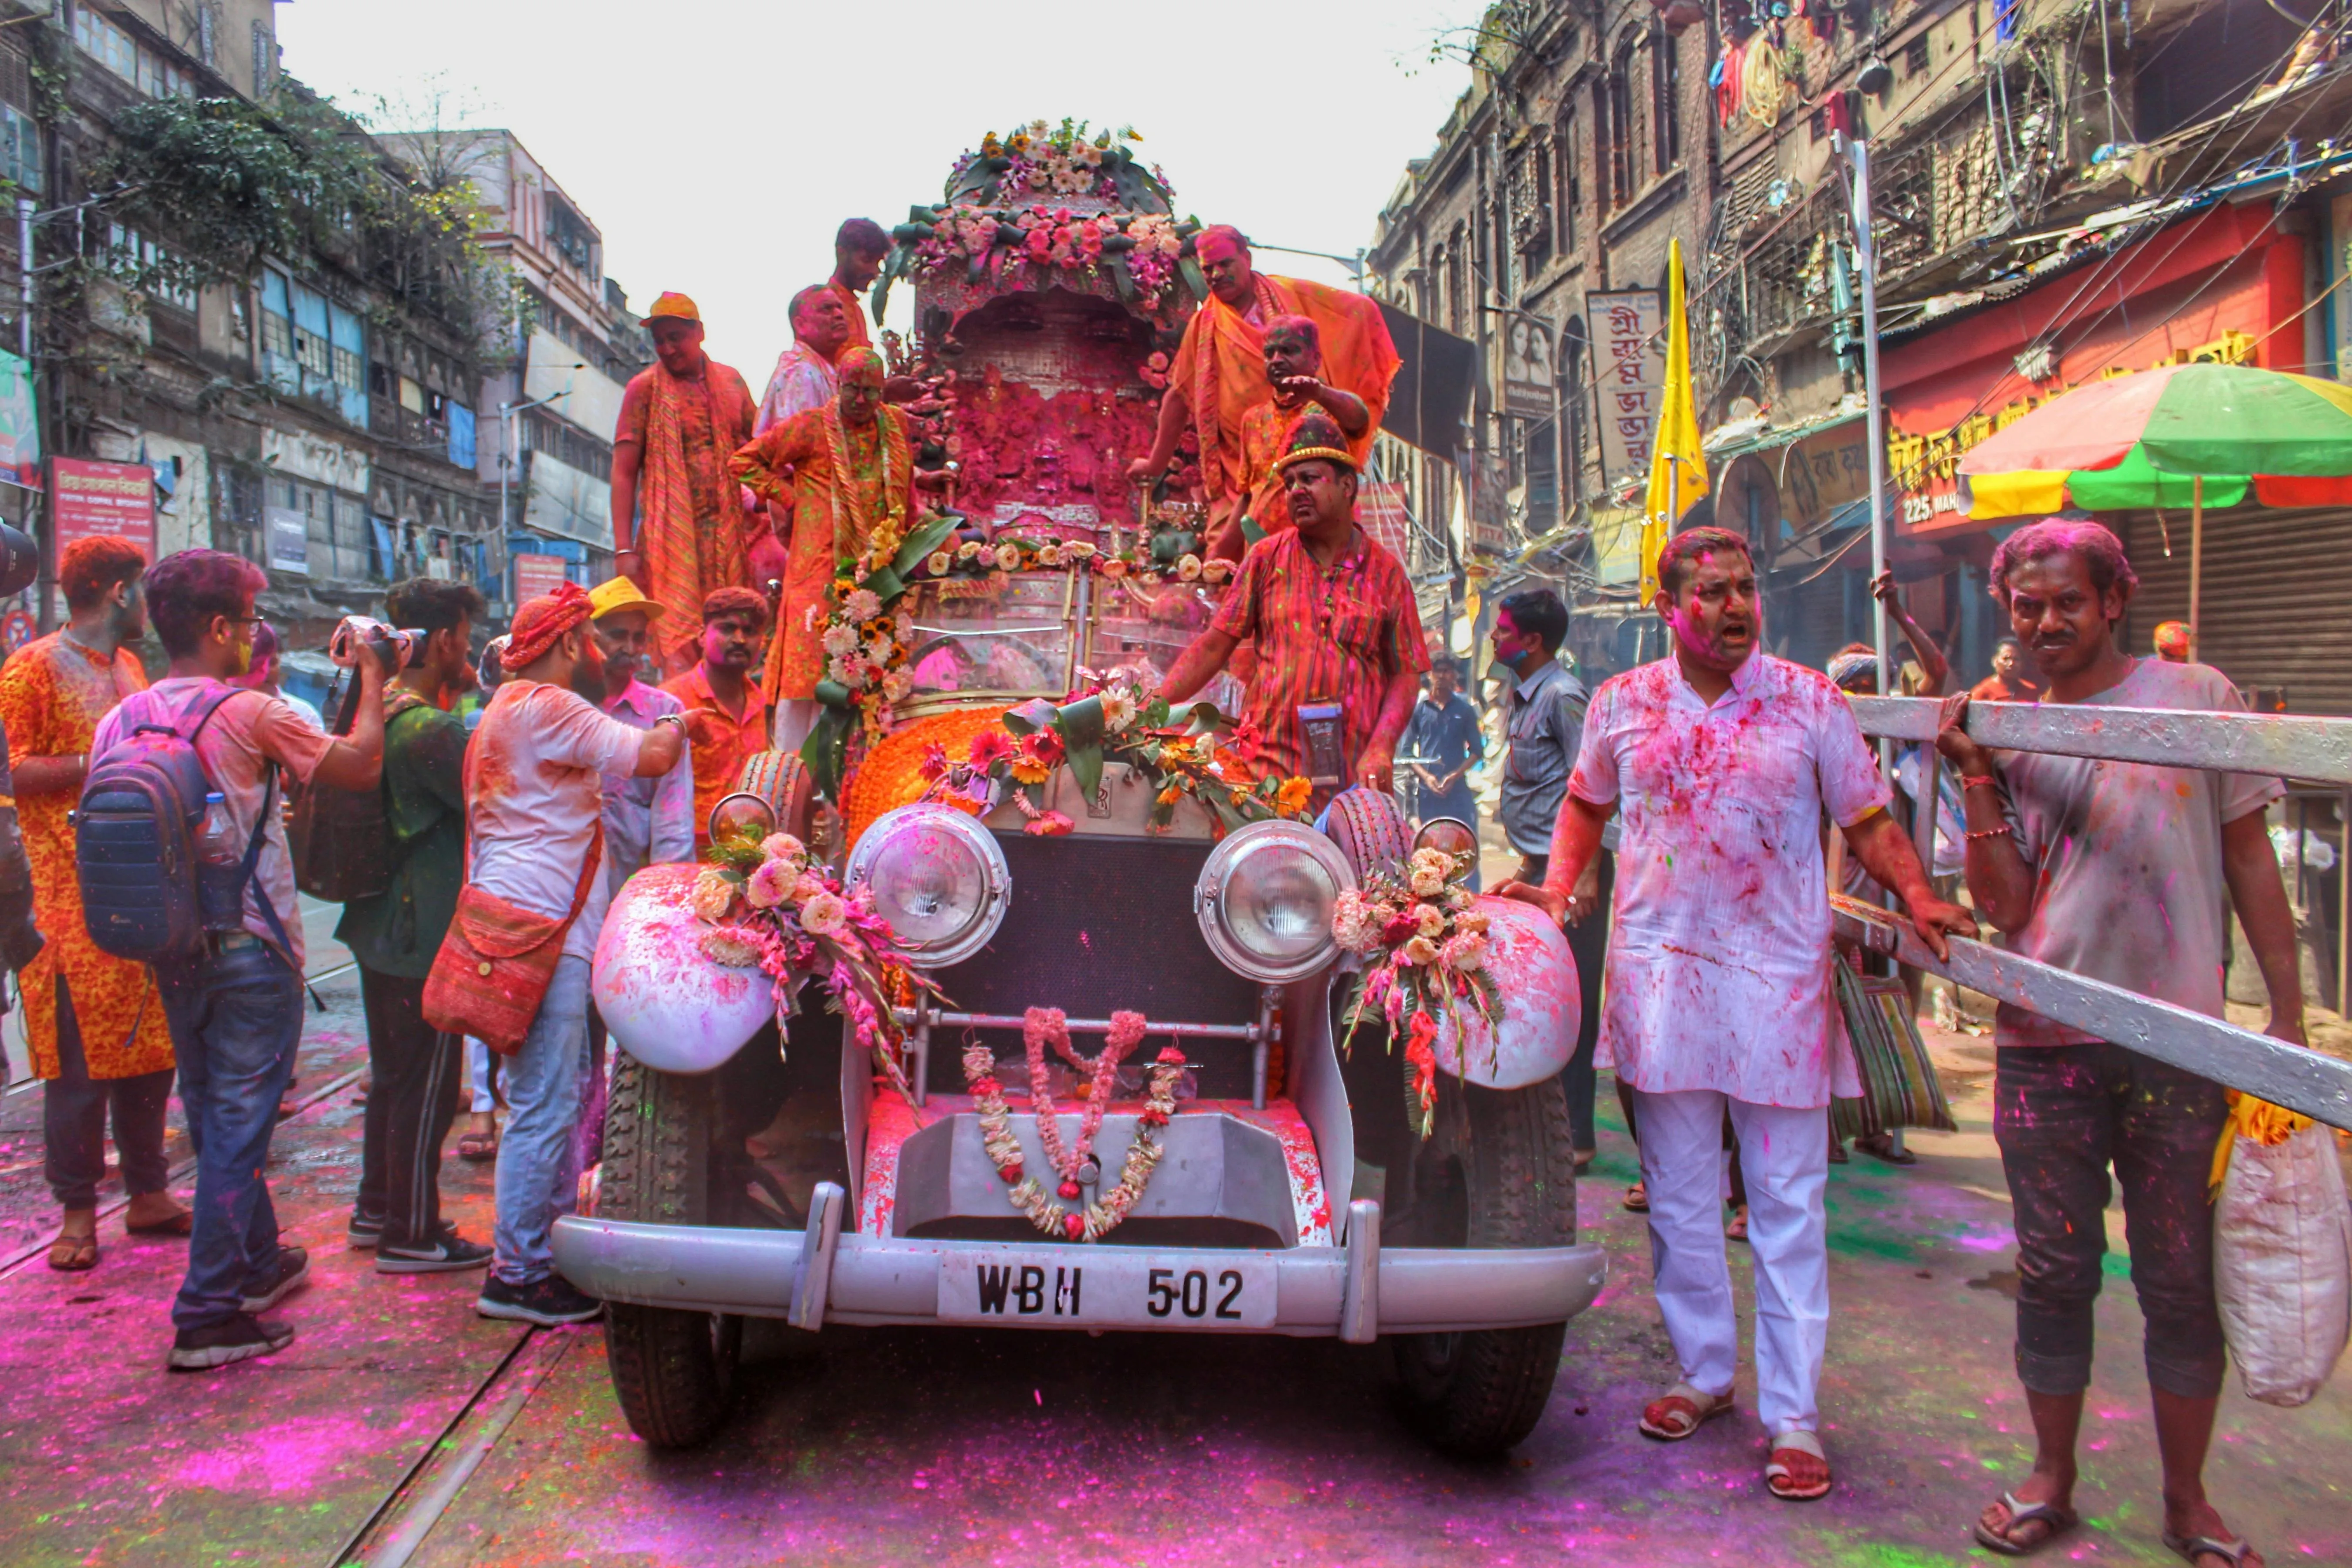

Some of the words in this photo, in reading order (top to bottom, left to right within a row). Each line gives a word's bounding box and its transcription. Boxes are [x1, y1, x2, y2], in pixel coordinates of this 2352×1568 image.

[1903, 495, 1933, 524] 225,
[977, 1264, 1082, 1316] WBH
[1147, 1269, 1244, 1319] 502
